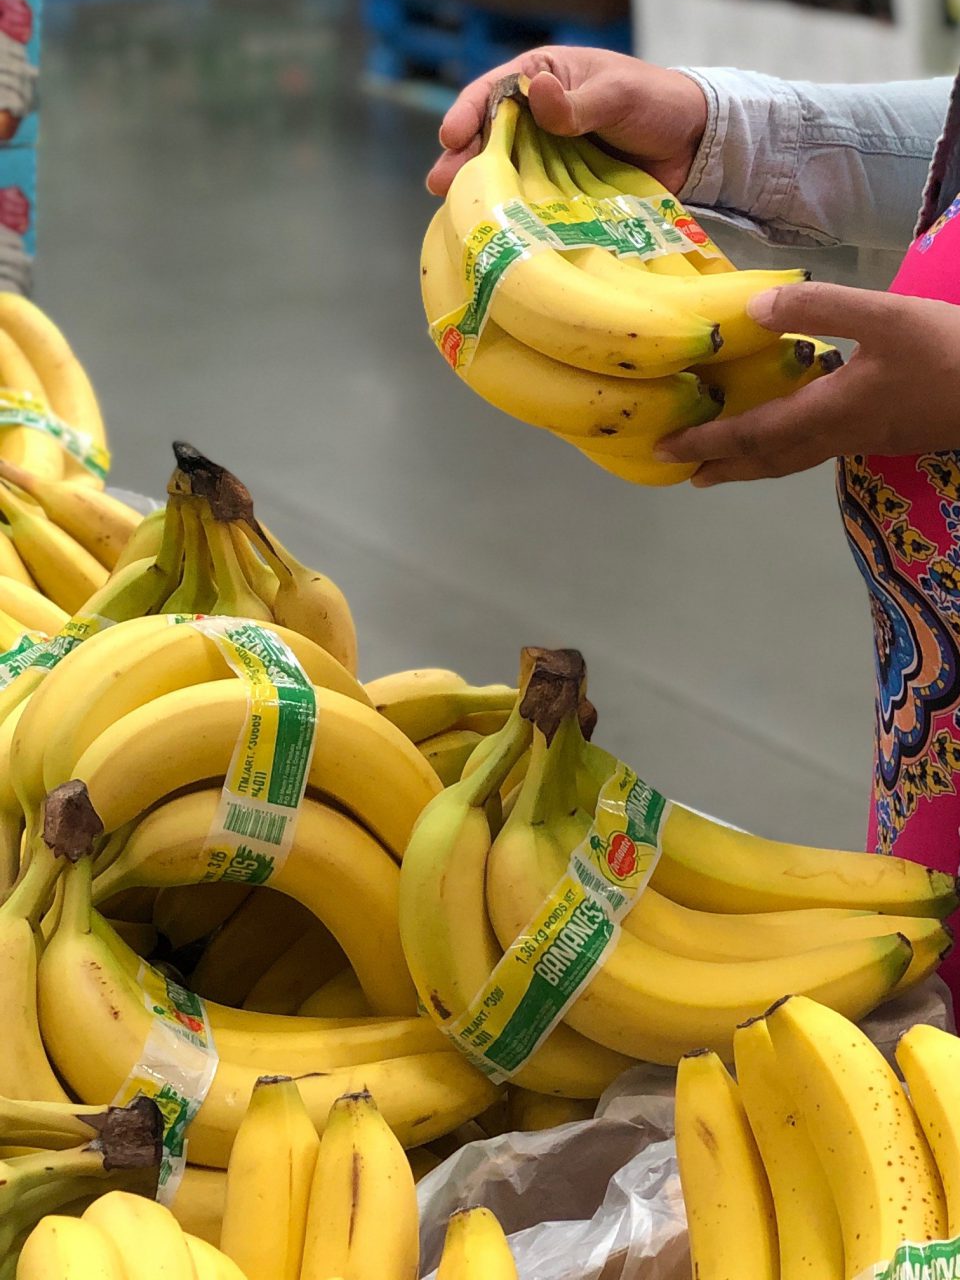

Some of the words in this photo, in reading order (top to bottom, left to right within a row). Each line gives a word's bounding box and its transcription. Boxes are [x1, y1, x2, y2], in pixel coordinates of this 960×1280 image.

[515, 941, 537, 965] 1.36
[543, 902, 568, 930] POIDS
[535, 899, 604, 987] BANANES
